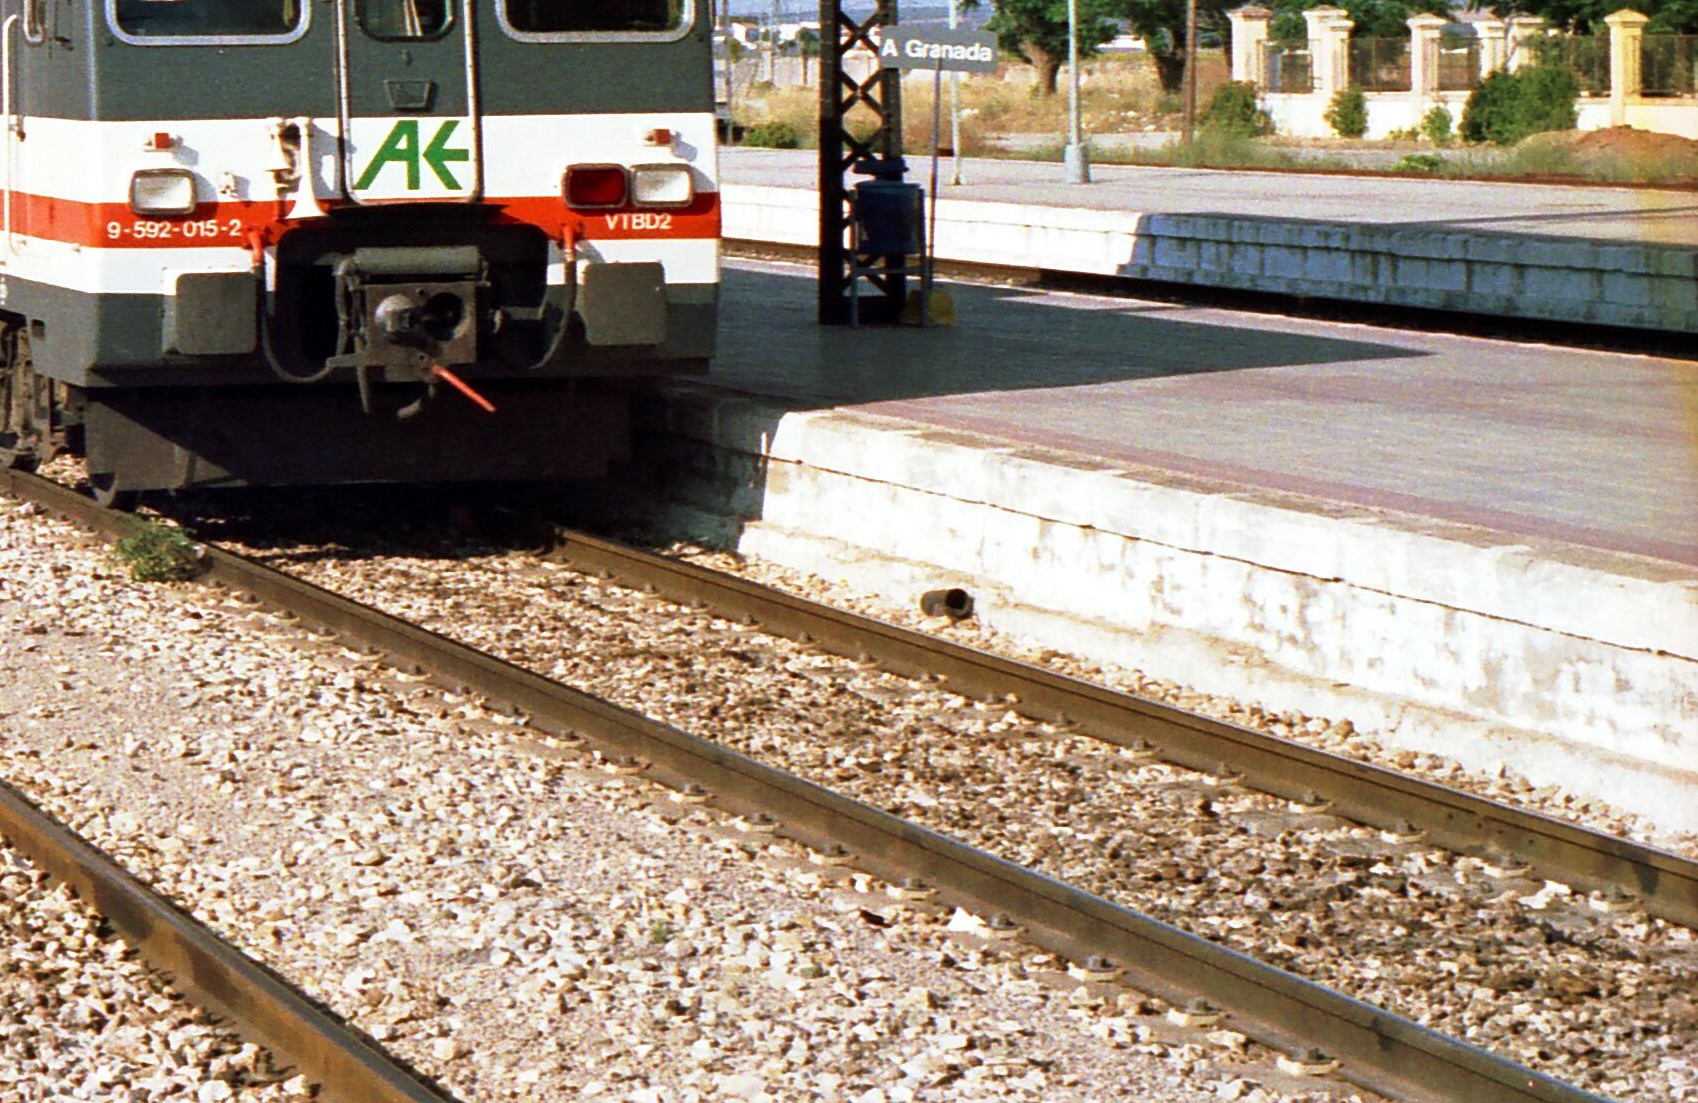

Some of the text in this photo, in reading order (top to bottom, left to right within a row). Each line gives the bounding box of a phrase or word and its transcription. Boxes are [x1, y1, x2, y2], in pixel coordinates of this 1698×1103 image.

[882, 38, 992, 61] A Granada
[106, 219, 241, 239] 9-592-015-2
